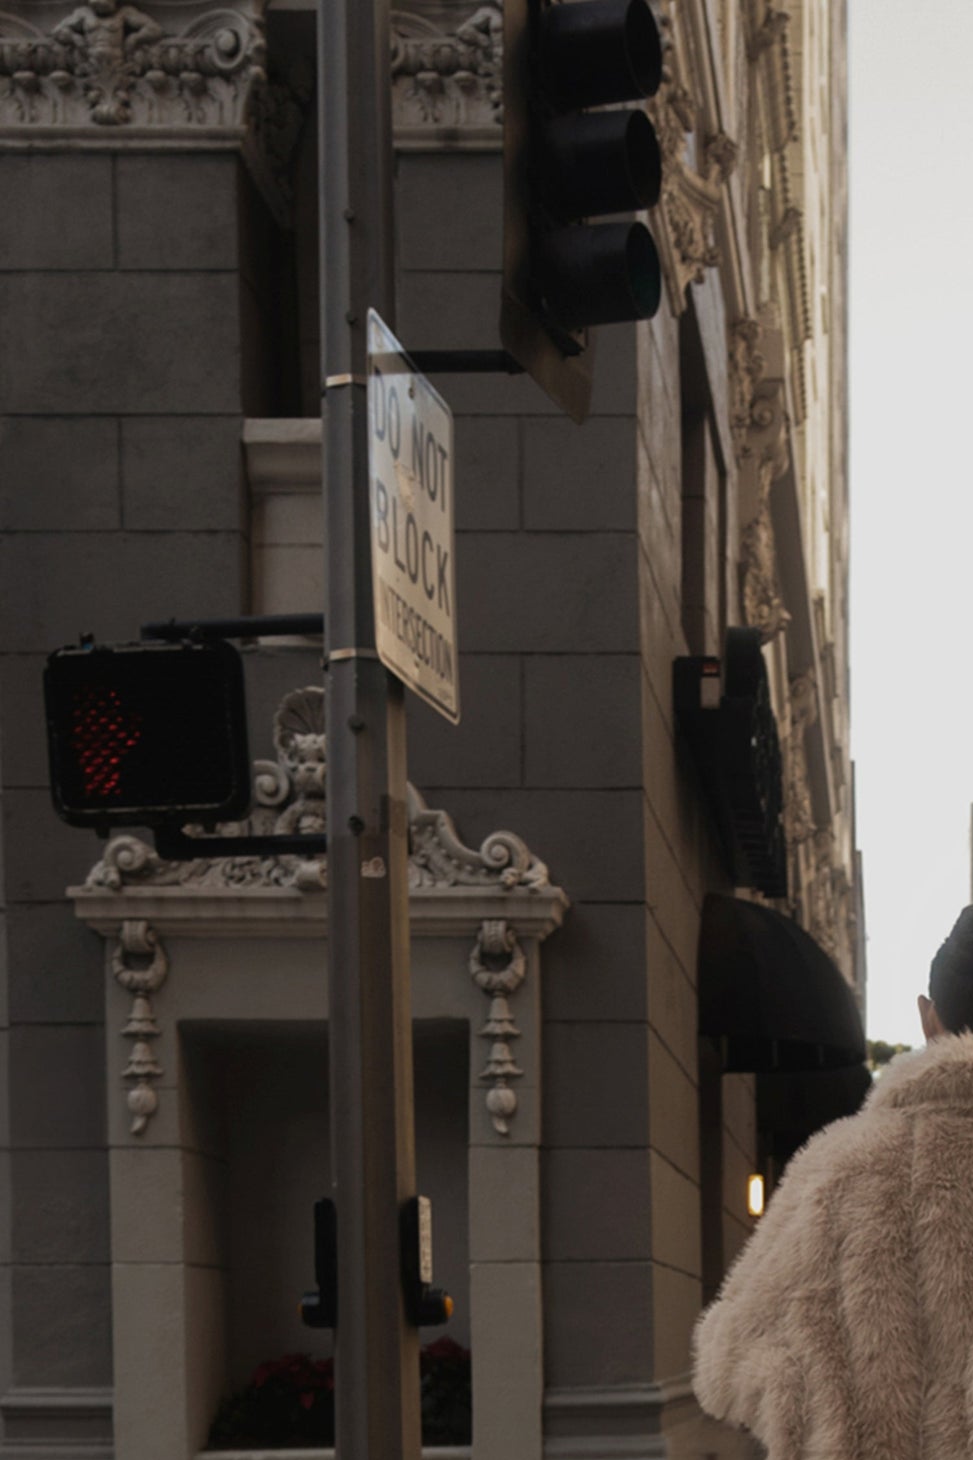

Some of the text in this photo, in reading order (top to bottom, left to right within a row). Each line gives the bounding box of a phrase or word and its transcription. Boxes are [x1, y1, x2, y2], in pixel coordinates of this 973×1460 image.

[374, 366, 448, 513] DO NOT
[376, 480, 450, 617] BLOCK
[379, 579, 454, 687] INTERSECTION
